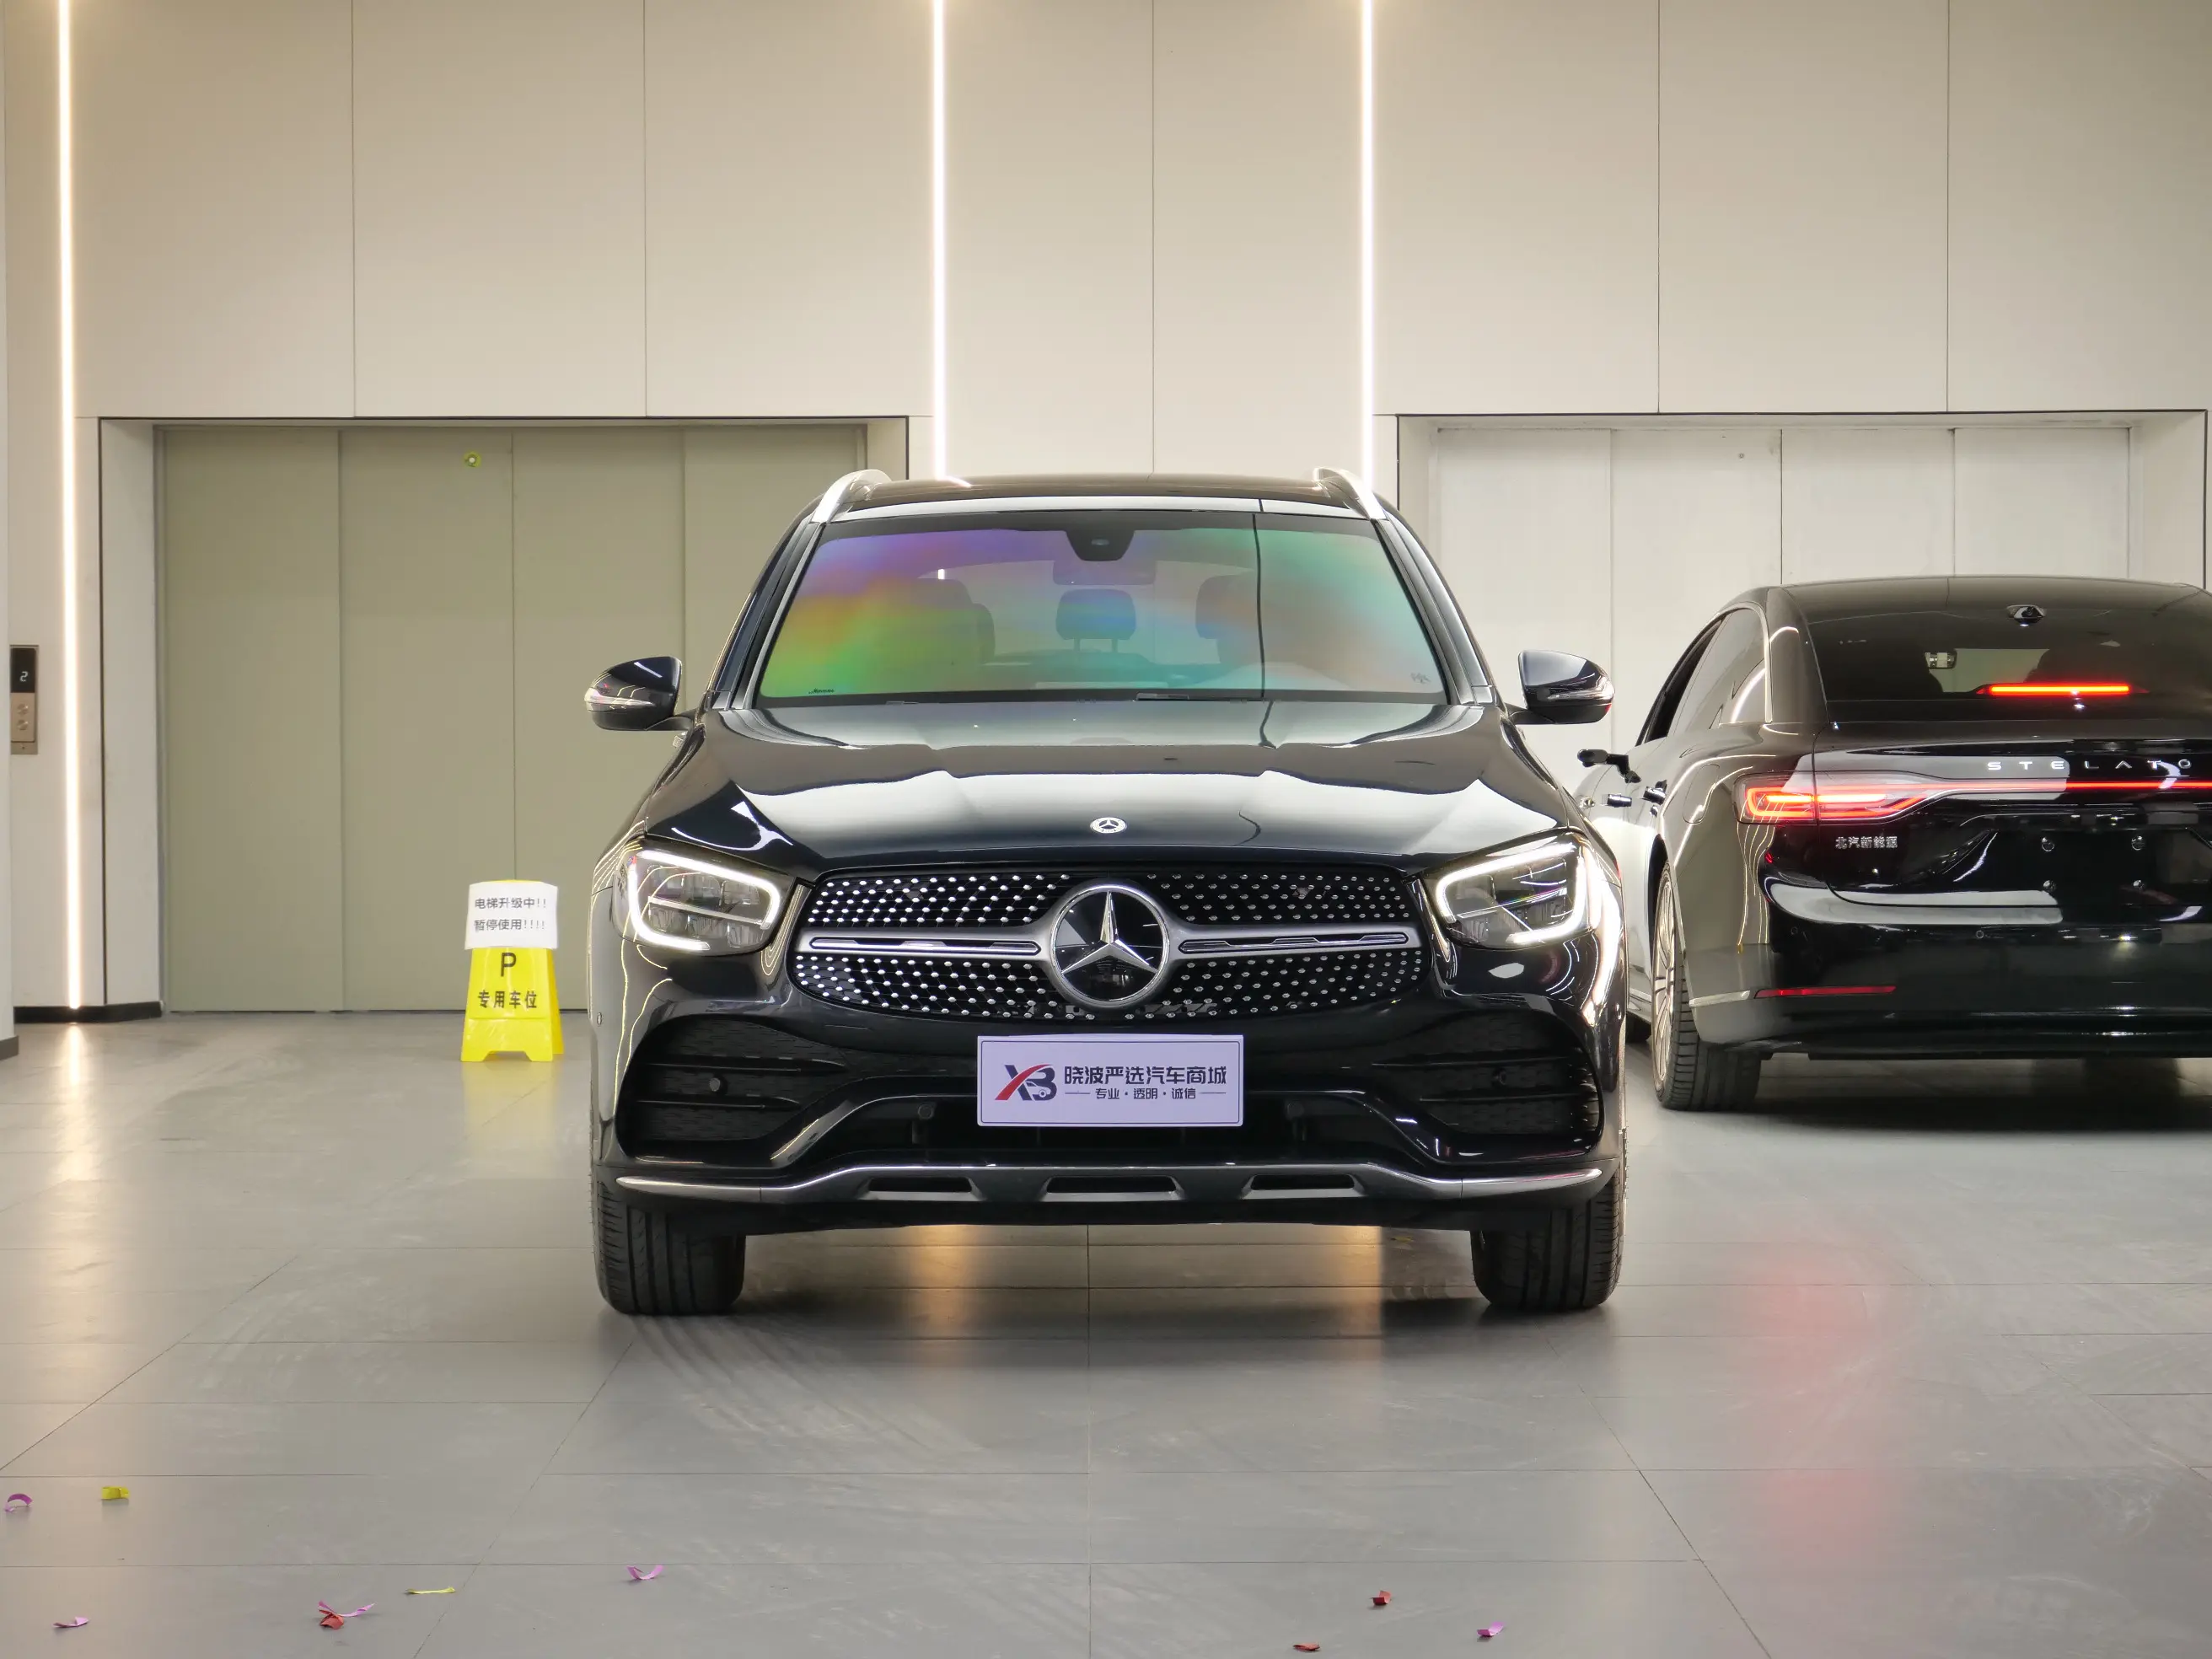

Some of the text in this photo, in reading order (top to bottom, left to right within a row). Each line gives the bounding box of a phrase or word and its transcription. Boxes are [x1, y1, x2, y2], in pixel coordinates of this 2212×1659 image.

[19, 671, 29, 682] 2
[1987, 759, 2192, 770] STELATO
[1835, 836, 1898, 849] 北汽新能源
[500, 952, 517, 977] P
[477, 990, 537, 1008] 专用车位
[1064, 1066, 1227, 1085] 晓波严选汽车商城
